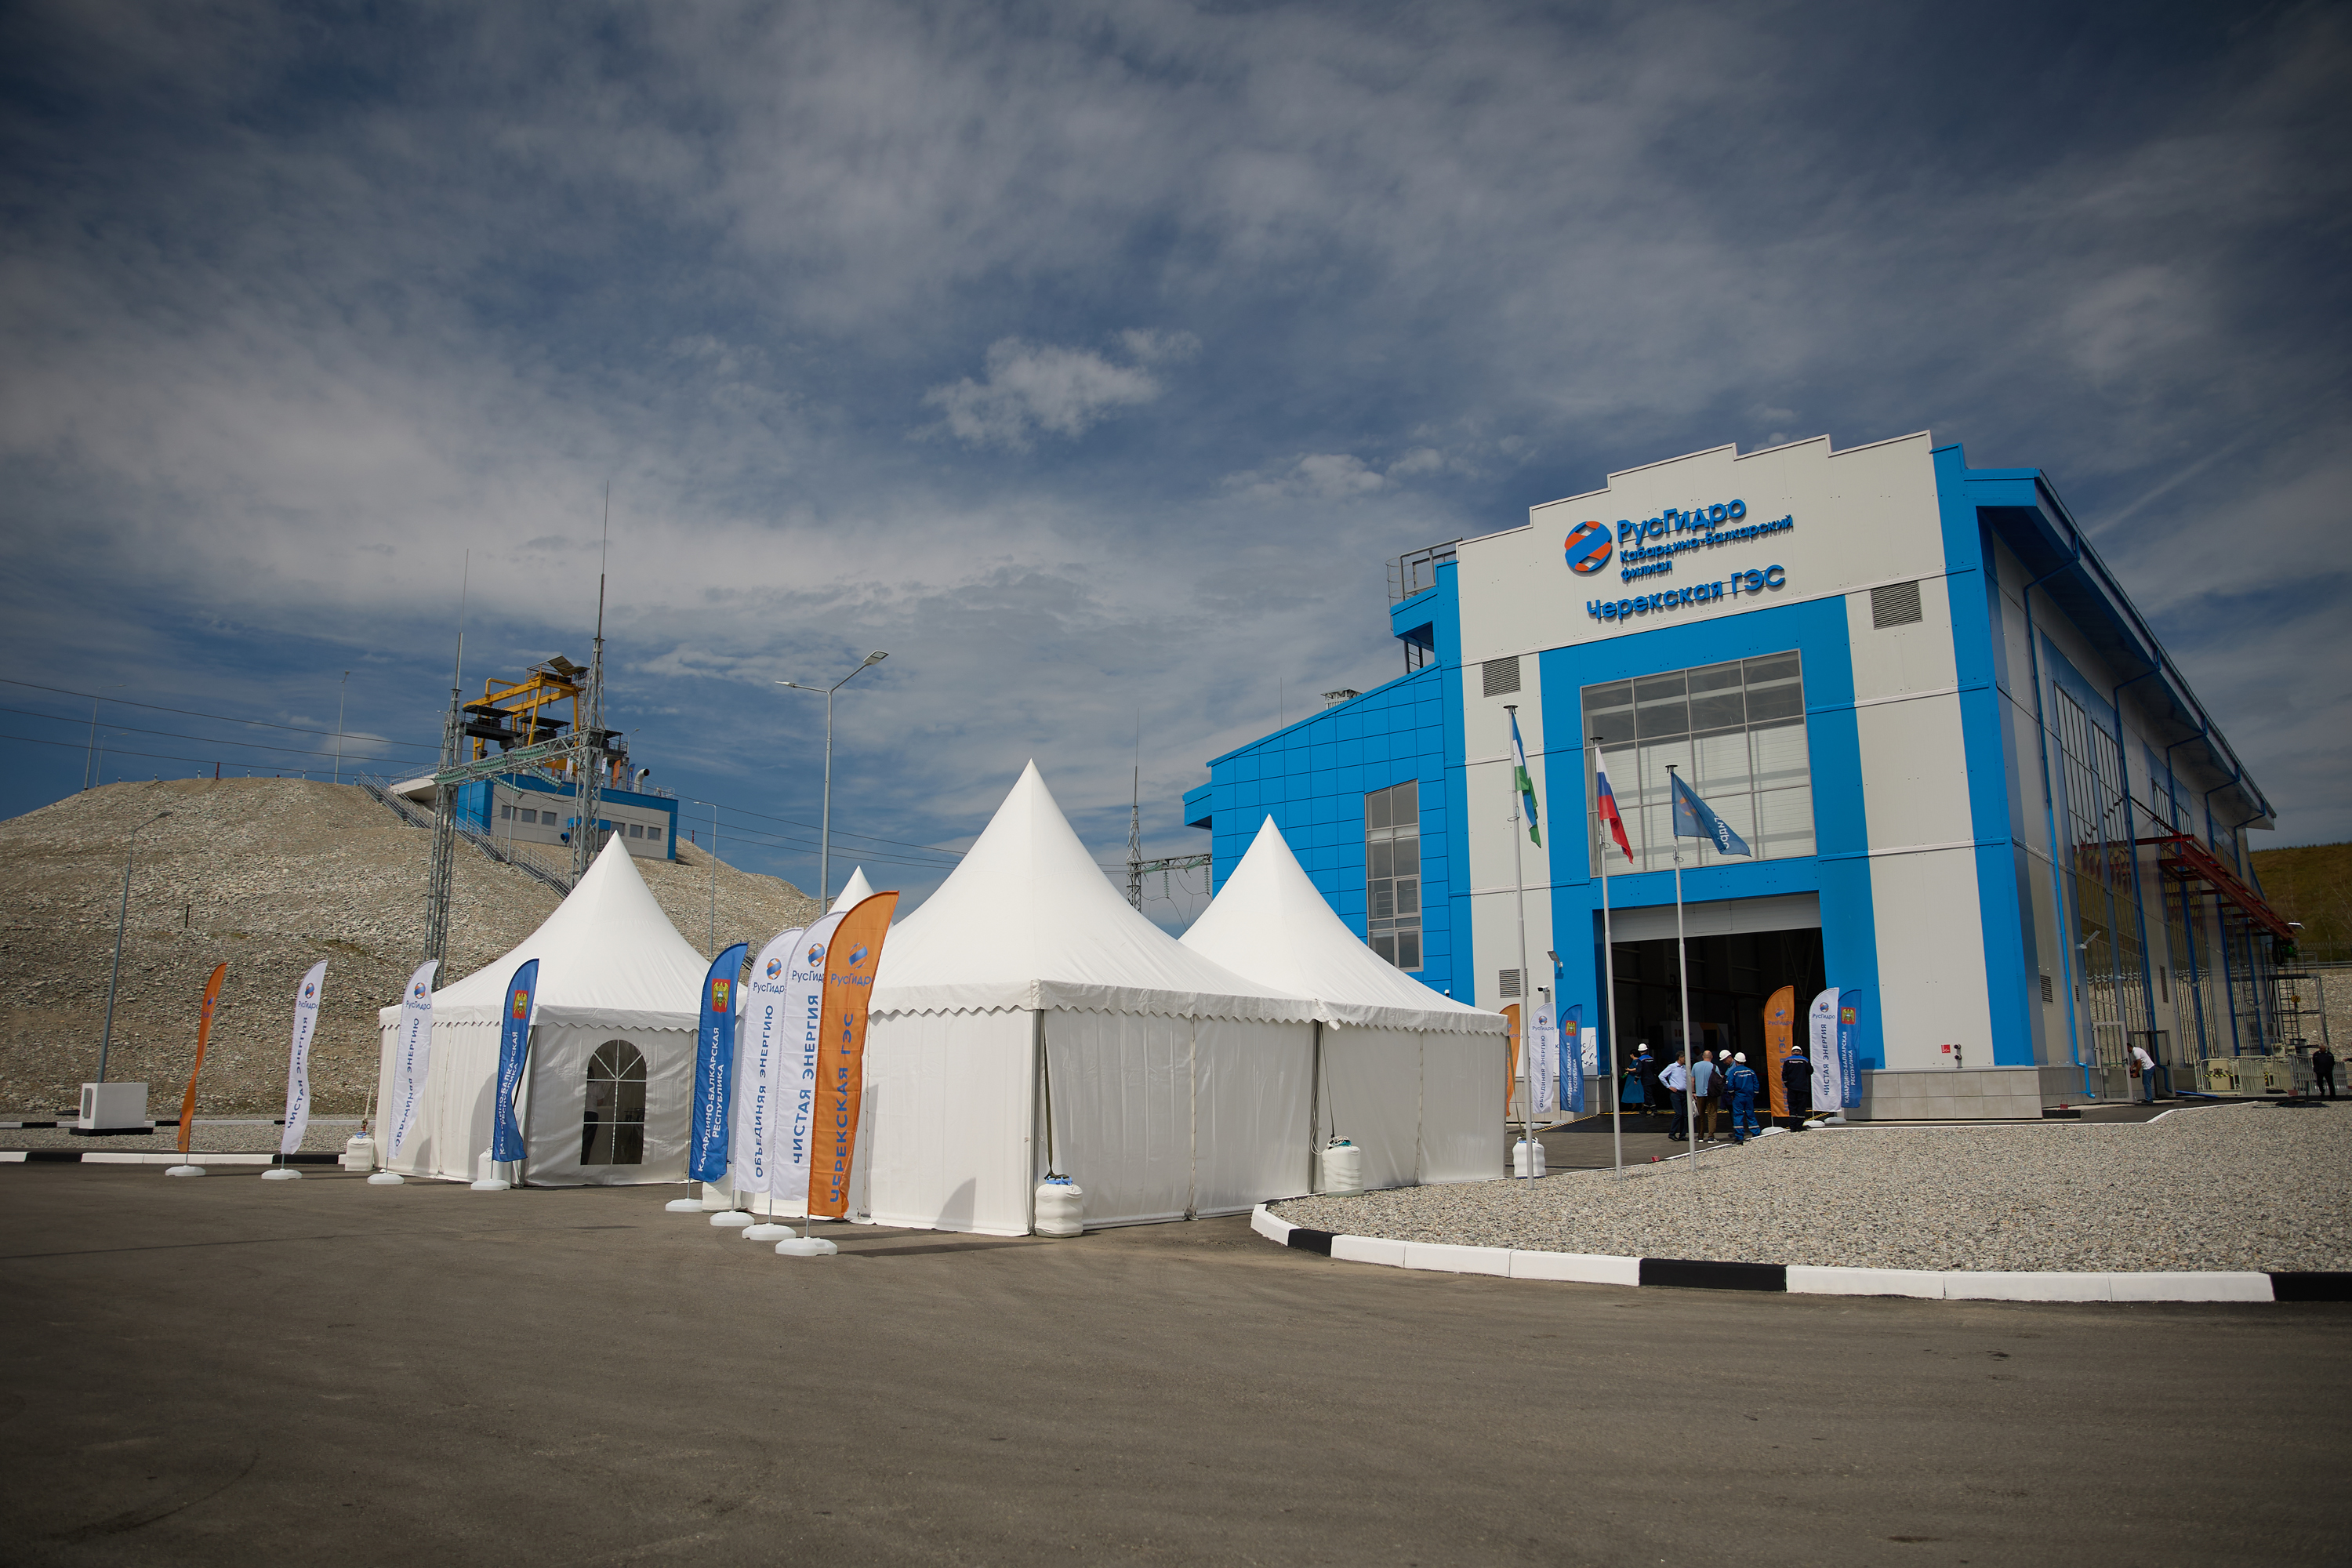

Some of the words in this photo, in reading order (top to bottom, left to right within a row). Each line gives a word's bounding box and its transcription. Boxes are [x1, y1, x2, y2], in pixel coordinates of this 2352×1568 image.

[1617, 499, 1746, 545] РусГидро
[1619, 514, 1794, 563] Кабардино-Балкарский
[1586, 580, 1723, 619] Черекская
[1731, 564, 1785, 593] ГЭС
[1621, 560, 1672, 582] филиал
[753, 982, 785, 994] РусГидр
[792, 970, 824, 983] РусГид
[830, 973, 873, 987] РусГидр
[406, 1018, 419, 1073] ЭНЕРГИЮ
[759, 1005, 774, 1079] ЭНЕРГИЮ
[840, 1013, 854, 1055] ГЭС
[1820, 1024, 1830, 1061] ЭНЕРГИЯ
[287, 1080, 304, 1129] ЧИСТАЯ
[296, 1017, 308, 1075] ЭНЕРГИЯ
[793, 1089, 811, 1163] ЧИСТАЯ
[802, 995, 818, 1080] ЭНЕРГИЯ
[1841, 1031, 1849, 1103] КАБАРДИНО-БАЛКАРСКАЯ
[712, 1064, 724, 1138] РЕСПУБЛИКА
